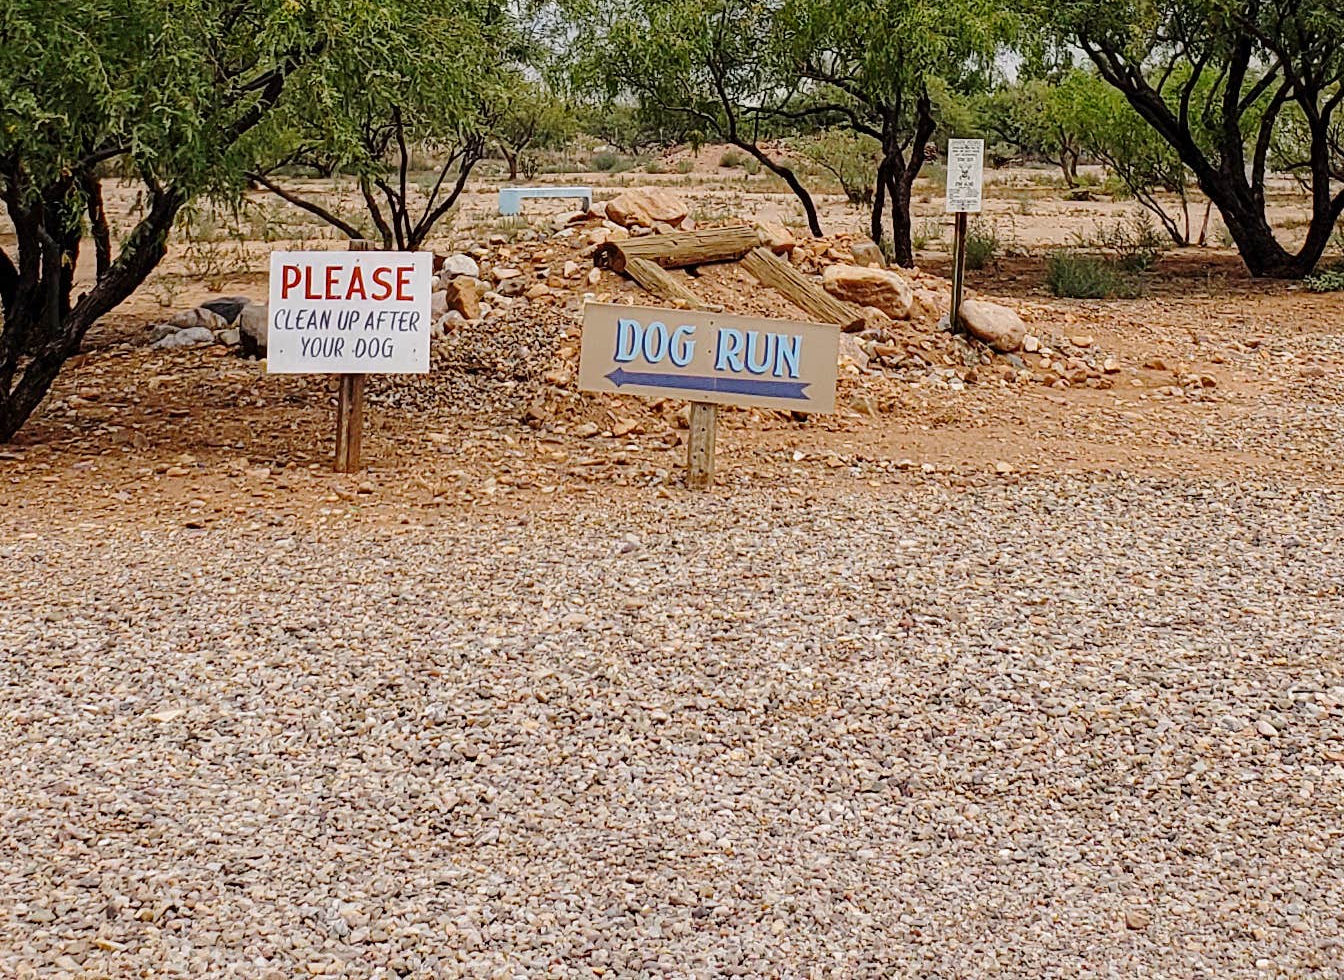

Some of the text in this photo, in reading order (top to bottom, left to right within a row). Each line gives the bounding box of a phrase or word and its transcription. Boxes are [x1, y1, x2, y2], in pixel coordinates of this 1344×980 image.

[281, 265, 415, 301] PLEASE
[274, 308, 420, 331] CLEAN UP AFTER
[301, 336, 393, 358] YOUR DOG
[614, 318, 803, 378] DOG RUN
